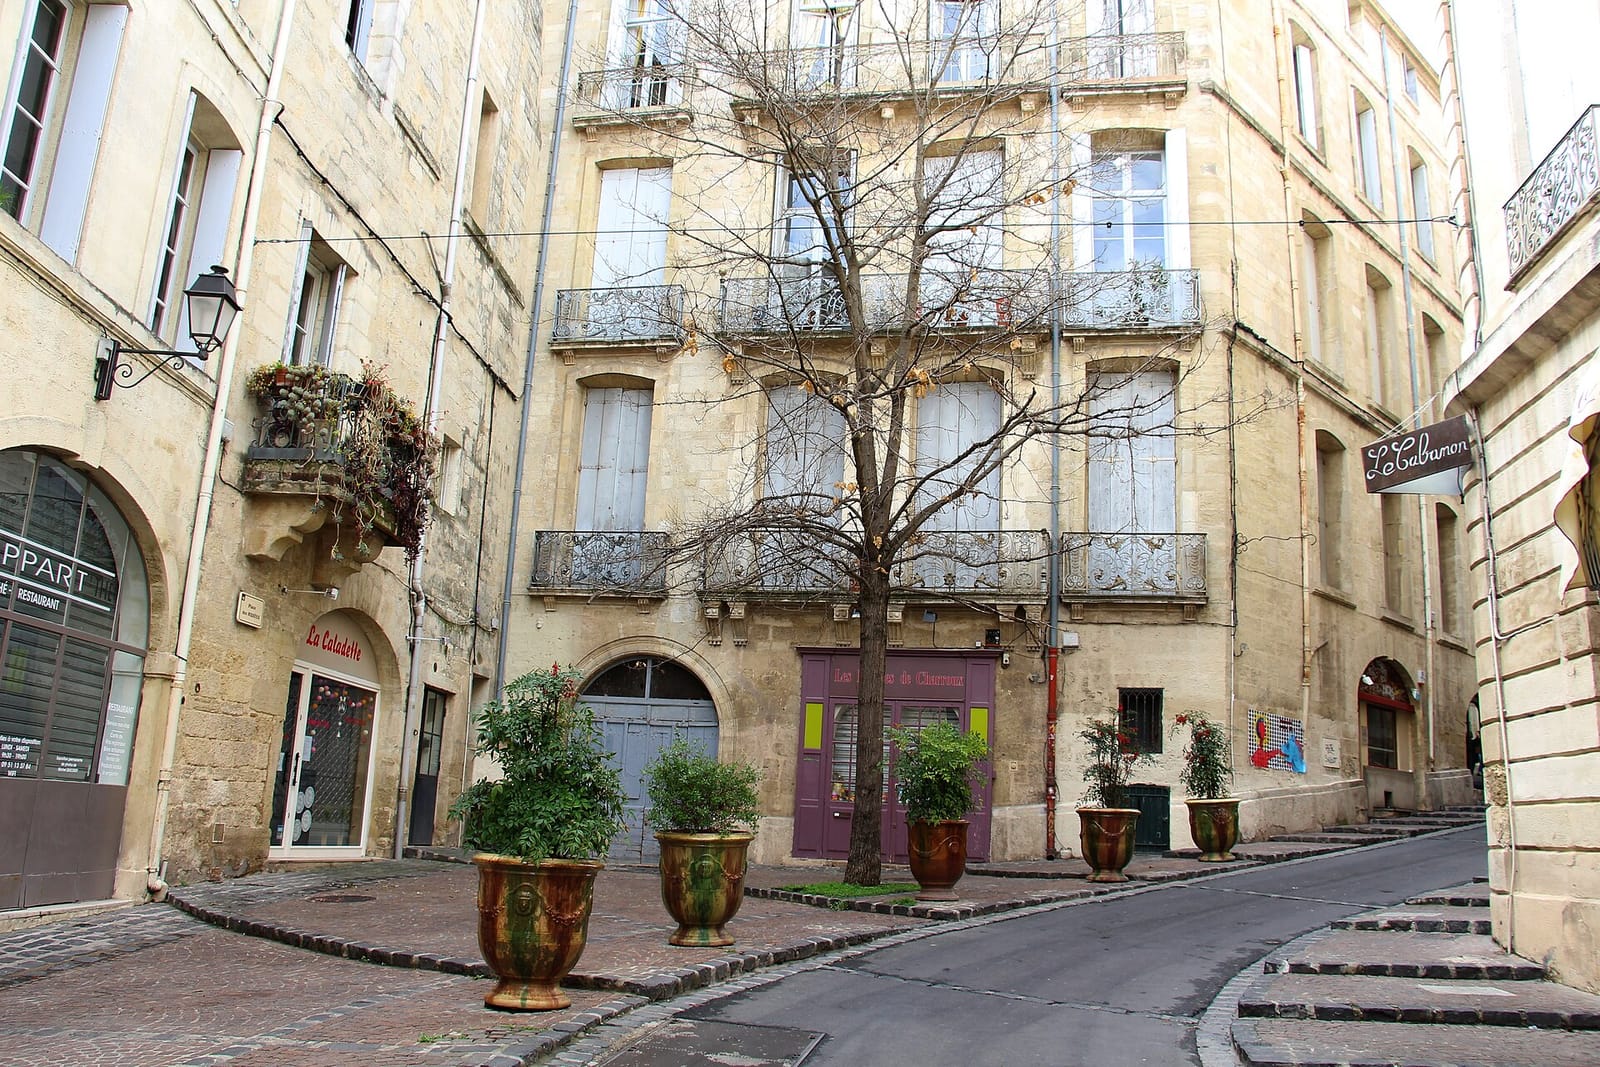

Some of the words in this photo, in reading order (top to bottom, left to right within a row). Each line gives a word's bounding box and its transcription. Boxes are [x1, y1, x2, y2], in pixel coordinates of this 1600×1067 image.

[1366, 445, 1396, 480] Le
[1391, 432, 1469, 471] Cabanon
[2, 542, 89, 592] PPART
[17, 587, 60, 611] RESTAURANT
[306, 624, 320, 647] La
[322, 629, 362, 662] Caladette
[834, 668, 852, 683] Les
[901, 670, 912, 685] de
[916, 671, 964, 687] Charroux
